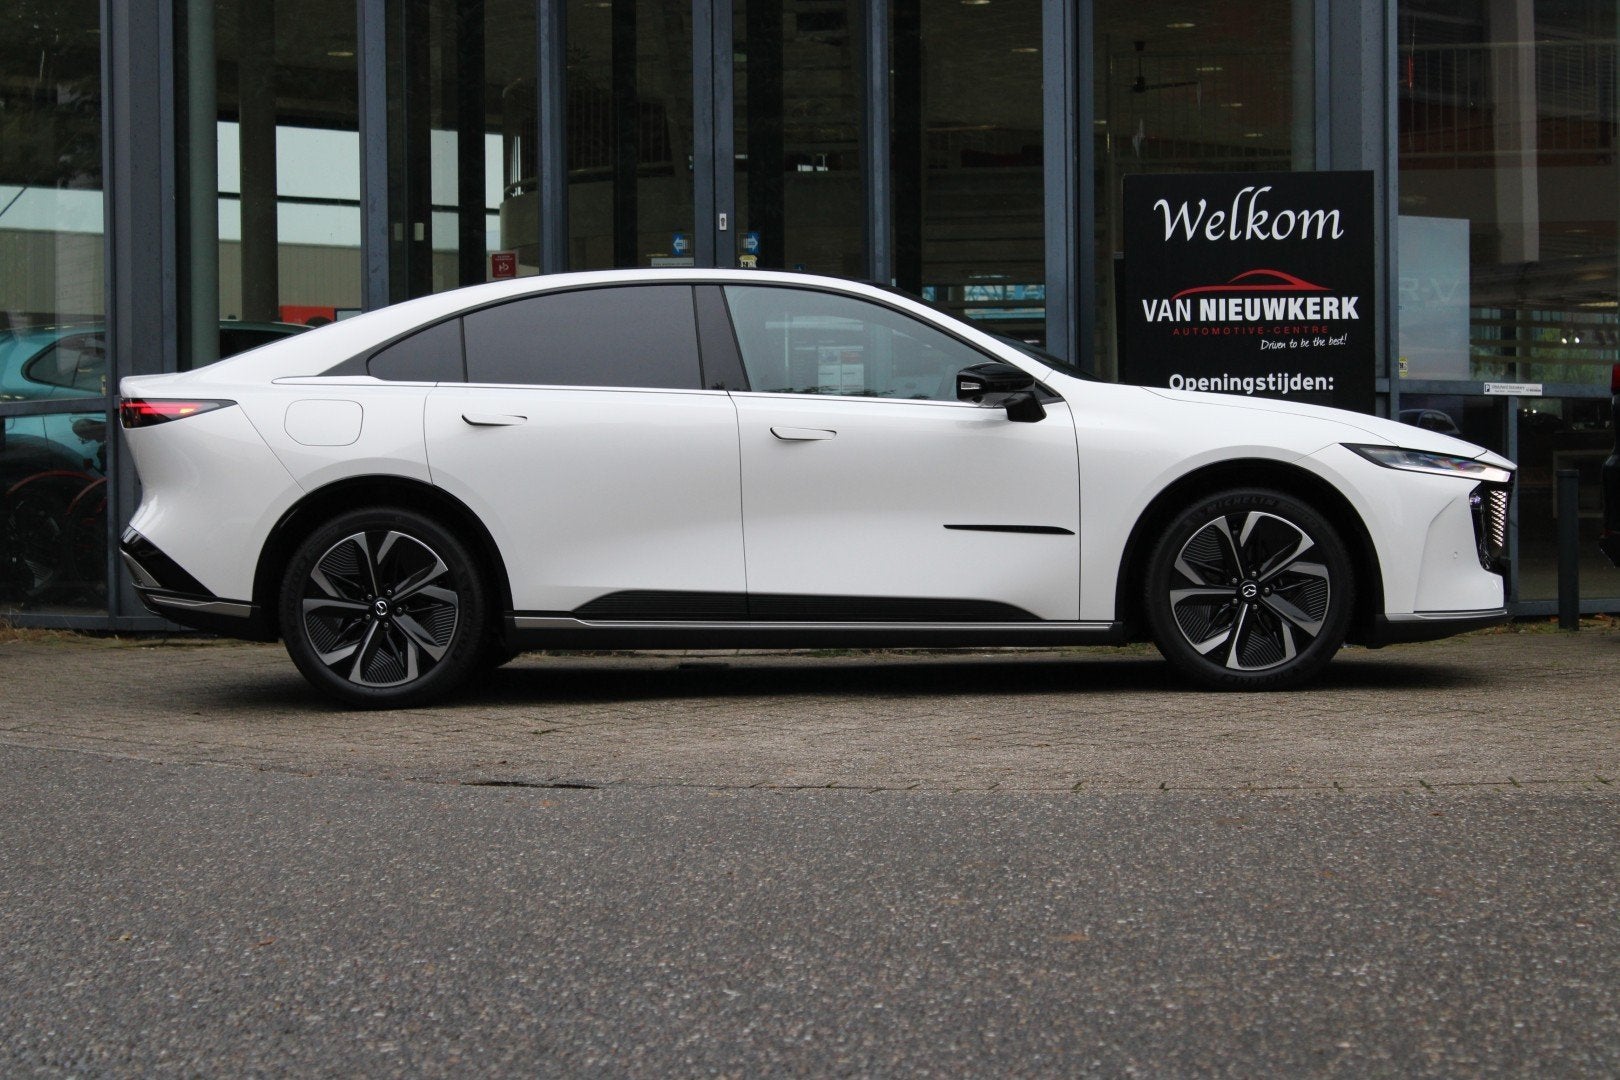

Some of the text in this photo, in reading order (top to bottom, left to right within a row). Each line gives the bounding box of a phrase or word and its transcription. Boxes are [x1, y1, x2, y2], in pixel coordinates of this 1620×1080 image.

[1153, 186, 1344, 242] Welkom
[1142, 296, 1360, 323] VAN NIEUWKERK
[1173, 326, 1328, 336] AUTOMOTIVE-CENTRE
[1260, 332, 1348, 350] Driven to be the best!
[1169, 373, 1334, 394] Openingstijden:
